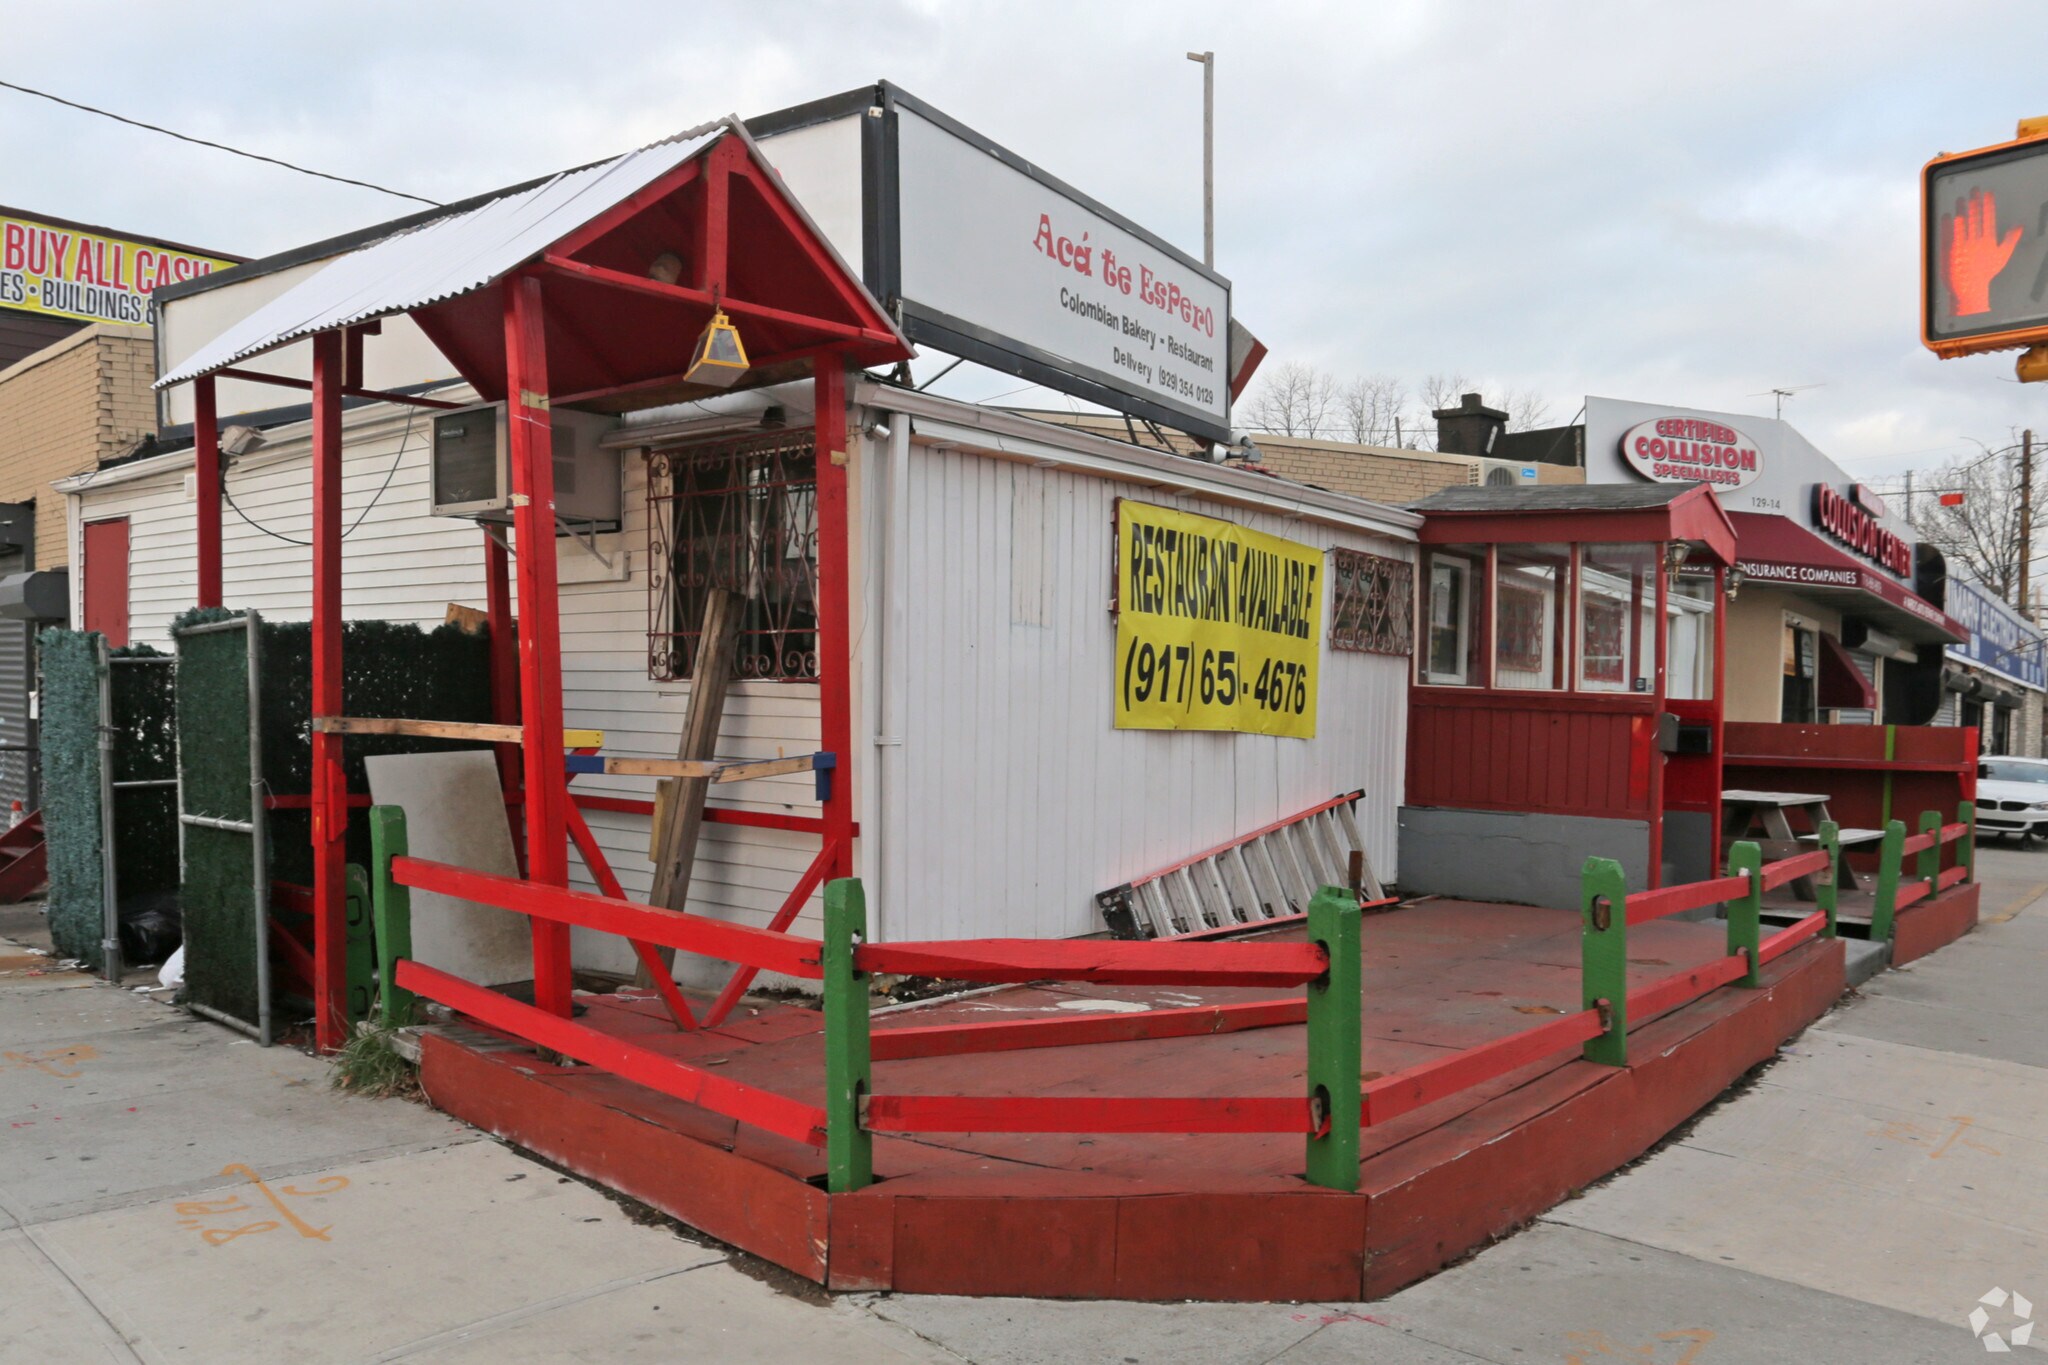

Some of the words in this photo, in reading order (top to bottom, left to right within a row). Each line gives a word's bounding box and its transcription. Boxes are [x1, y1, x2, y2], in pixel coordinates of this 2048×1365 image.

[5, 223, 70, 278] BUY
[75, 238, 128, 290] ALL
[1033, 213, 1092, 277] Acá
[1101, 249, 1132, 295] te
[42, 279, 141, 322] BUILDINGS
[1060, 287, 1119, 331] Colombian
[1122, 314, 1156, 350] Bakery
[1168, 335, 1213, 373] Restaurant
[1113, 346, 1152, 384] Delivery
[1159, 365, 1177, 392] (929)
[1179, 378, 1194, 398] 354
[1196, 385, 1213, 405] 0129
[1635, 436, 1757, 472] COLLISION
[1656, 419, 1738, 445] CERTIFIED
[1653, 463, 1740, 485] SPECIALISTS
[1751, 496, 1781, 510] 129-14
[1818, 482, 1878, 558] COLLISION
[1131, 522, 1238, 624] RESTAURANT
[1742, 562, 1797, 579] NSURANCE
[1800, 567, 1857, 584] COMPANIES
[1124, 636, 1194, 714] (917)
